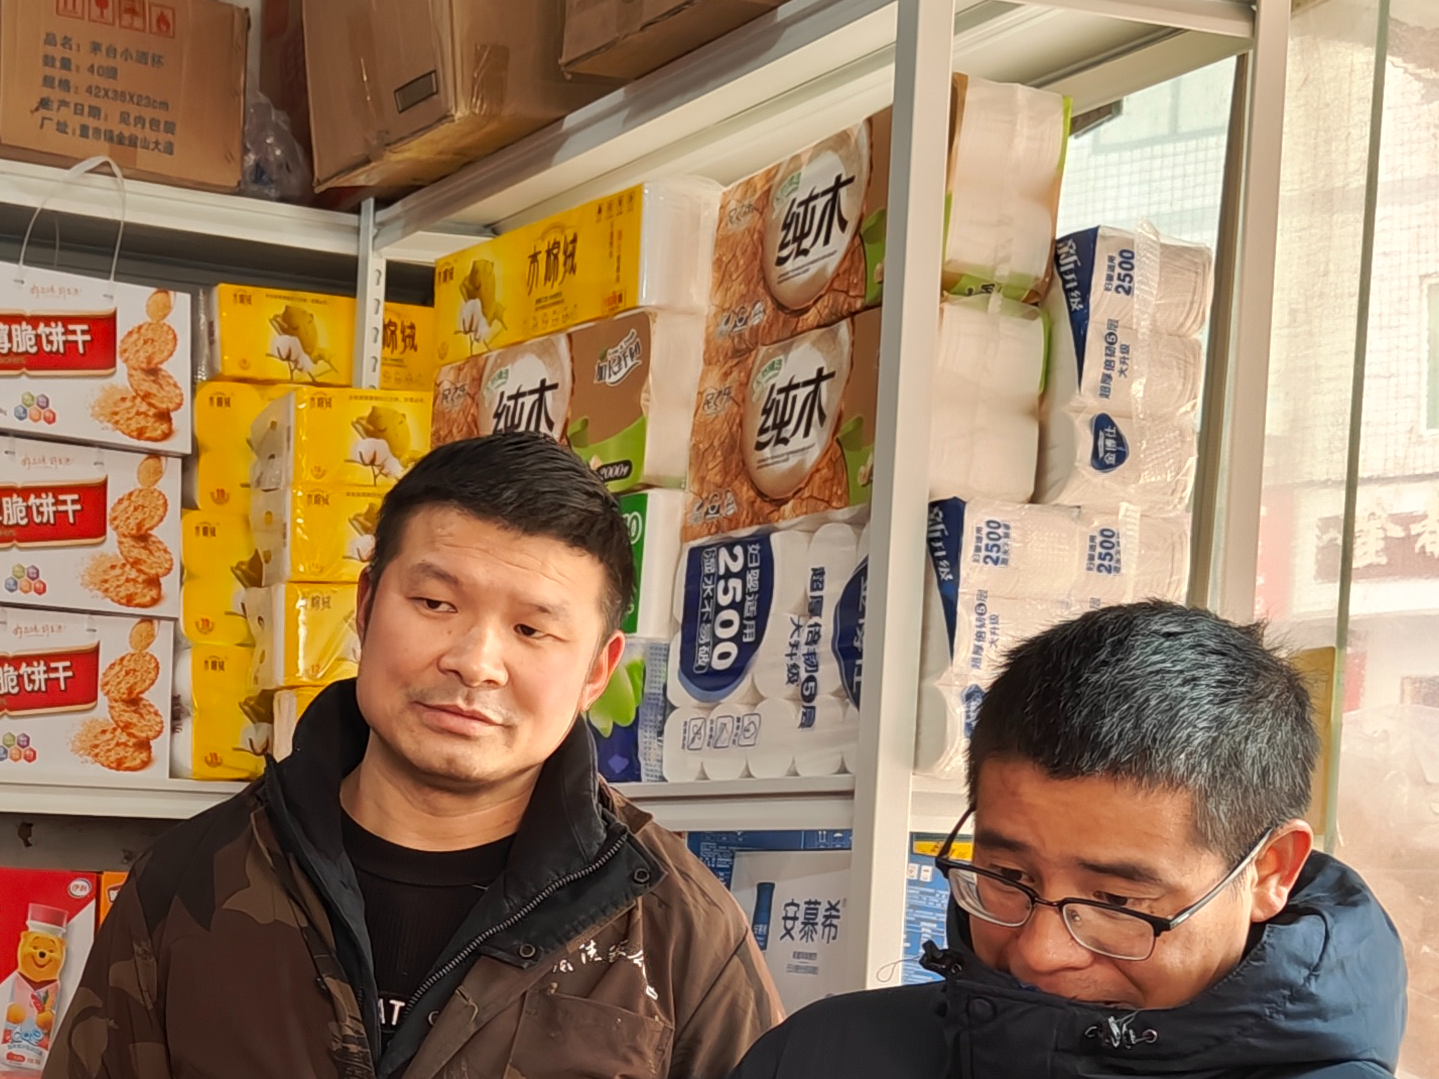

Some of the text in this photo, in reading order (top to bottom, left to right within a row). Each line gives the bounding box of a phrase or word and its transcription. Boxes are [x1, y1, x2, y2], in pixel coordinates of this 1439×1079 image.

[775, 173, 855, 267] 纯木
[1115, 249, 1136, 296] 2500
[754, 366, 836, 451] 纯木
[983, 519, 1003, 566] 2500
[1096, 528, 1116, 574] 2500
[711, 545, 744, 671] 2500
[742, 544, 761, 643] 妇婴适用
[784, 616, 804, 686] 大升级
[779, 897, 841, 944] 安慕希
